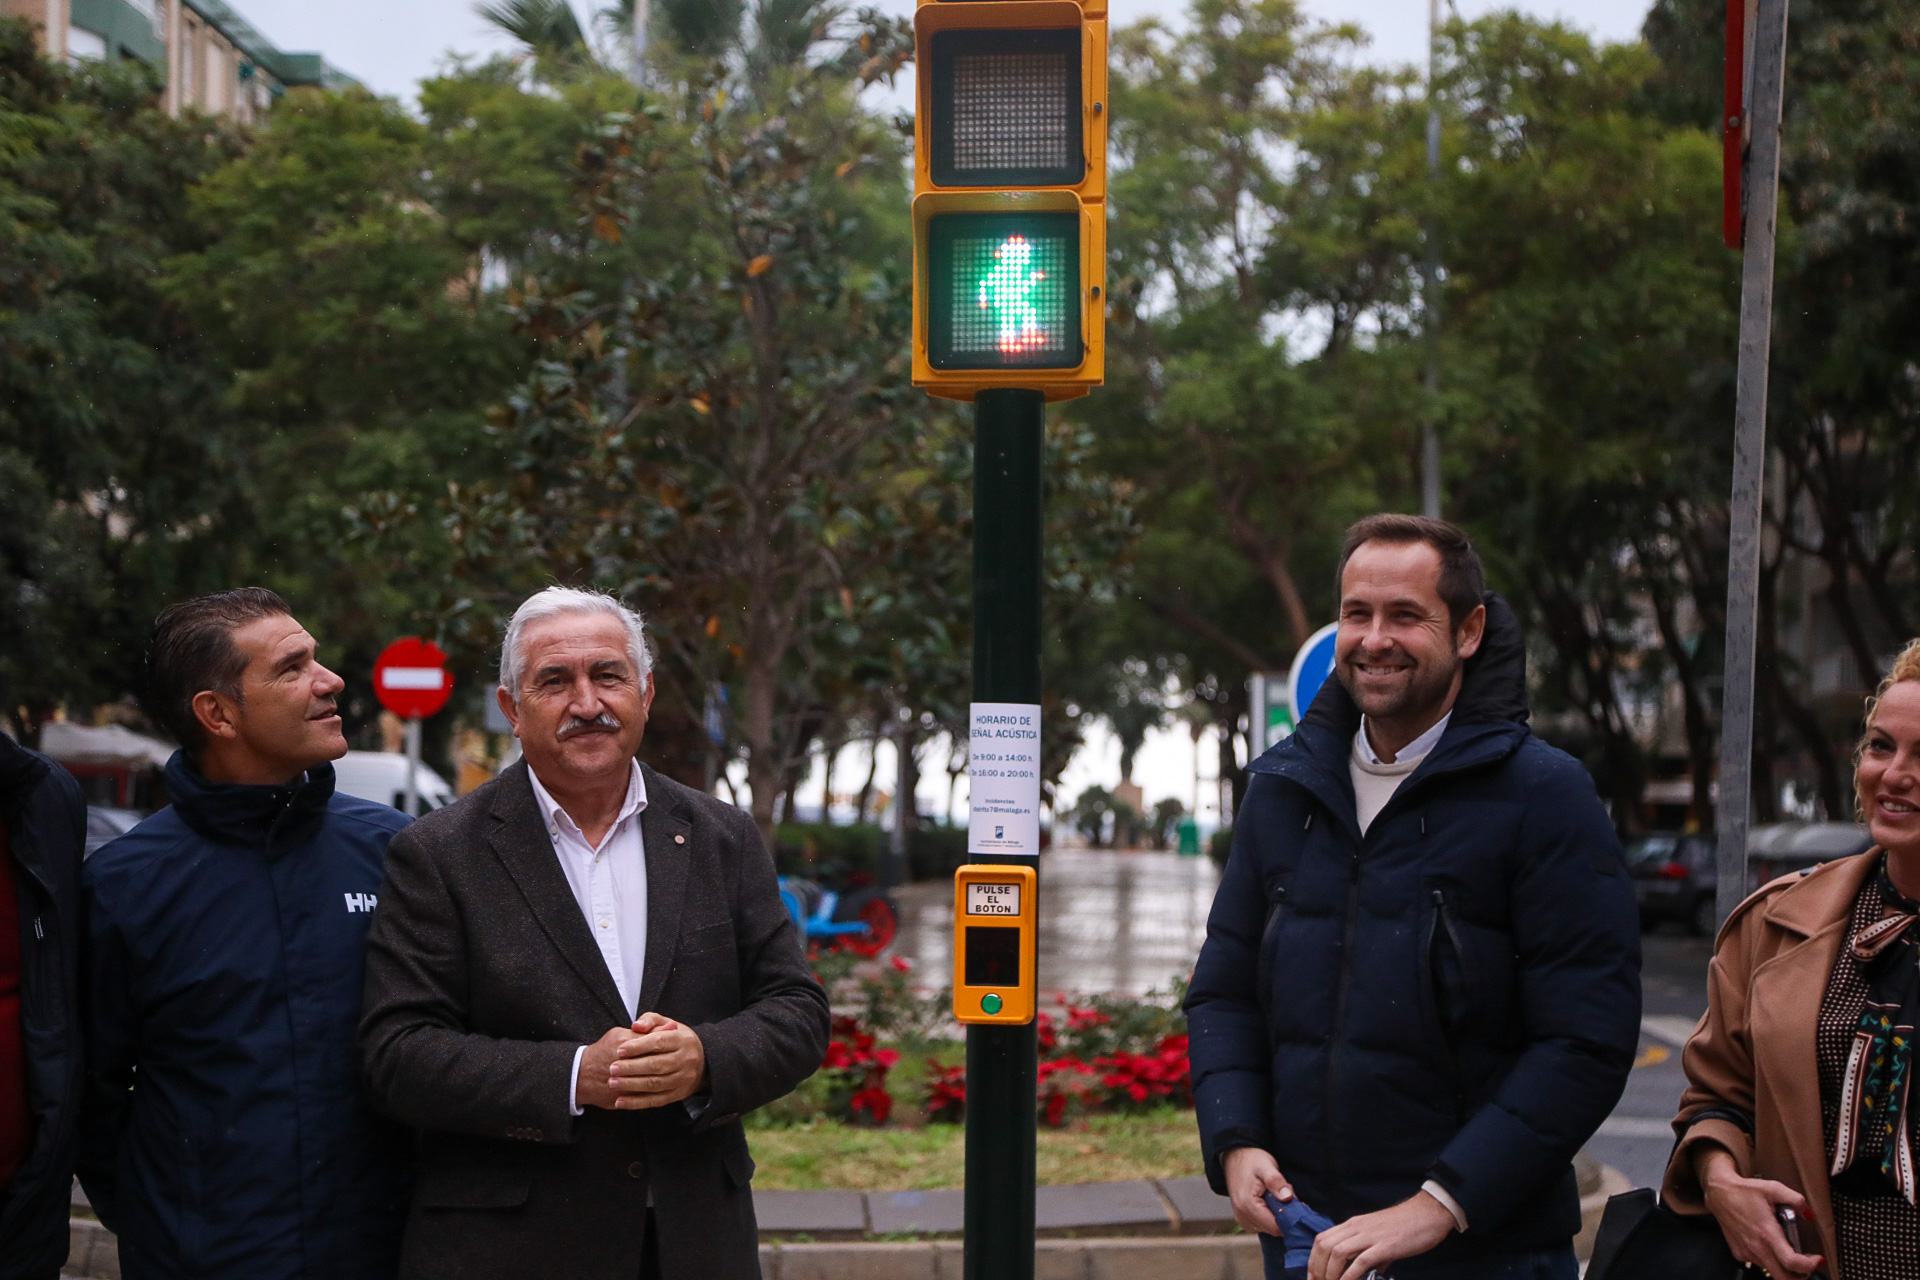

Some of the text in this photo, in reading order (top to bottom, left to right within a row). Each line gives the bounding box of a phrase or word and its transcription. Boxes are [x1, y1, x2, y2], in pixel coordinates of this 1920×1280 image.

[976, 715, 1031, 725] HORARIO DE
[971, 727, 1037, 739] SEÑAL ACÚSTICA
[980, 753, 996, 761] 9:00
[1005, 754, 1027, 762] 14:00
[978, 769, 998, 777] 16:00
[1007, 770, 1028, 778] 20:00
[976, 885, 1011, 895] PULSE
[987, 895, 1000, 904] EL
[975, 904, 1012, 913] BOTON
